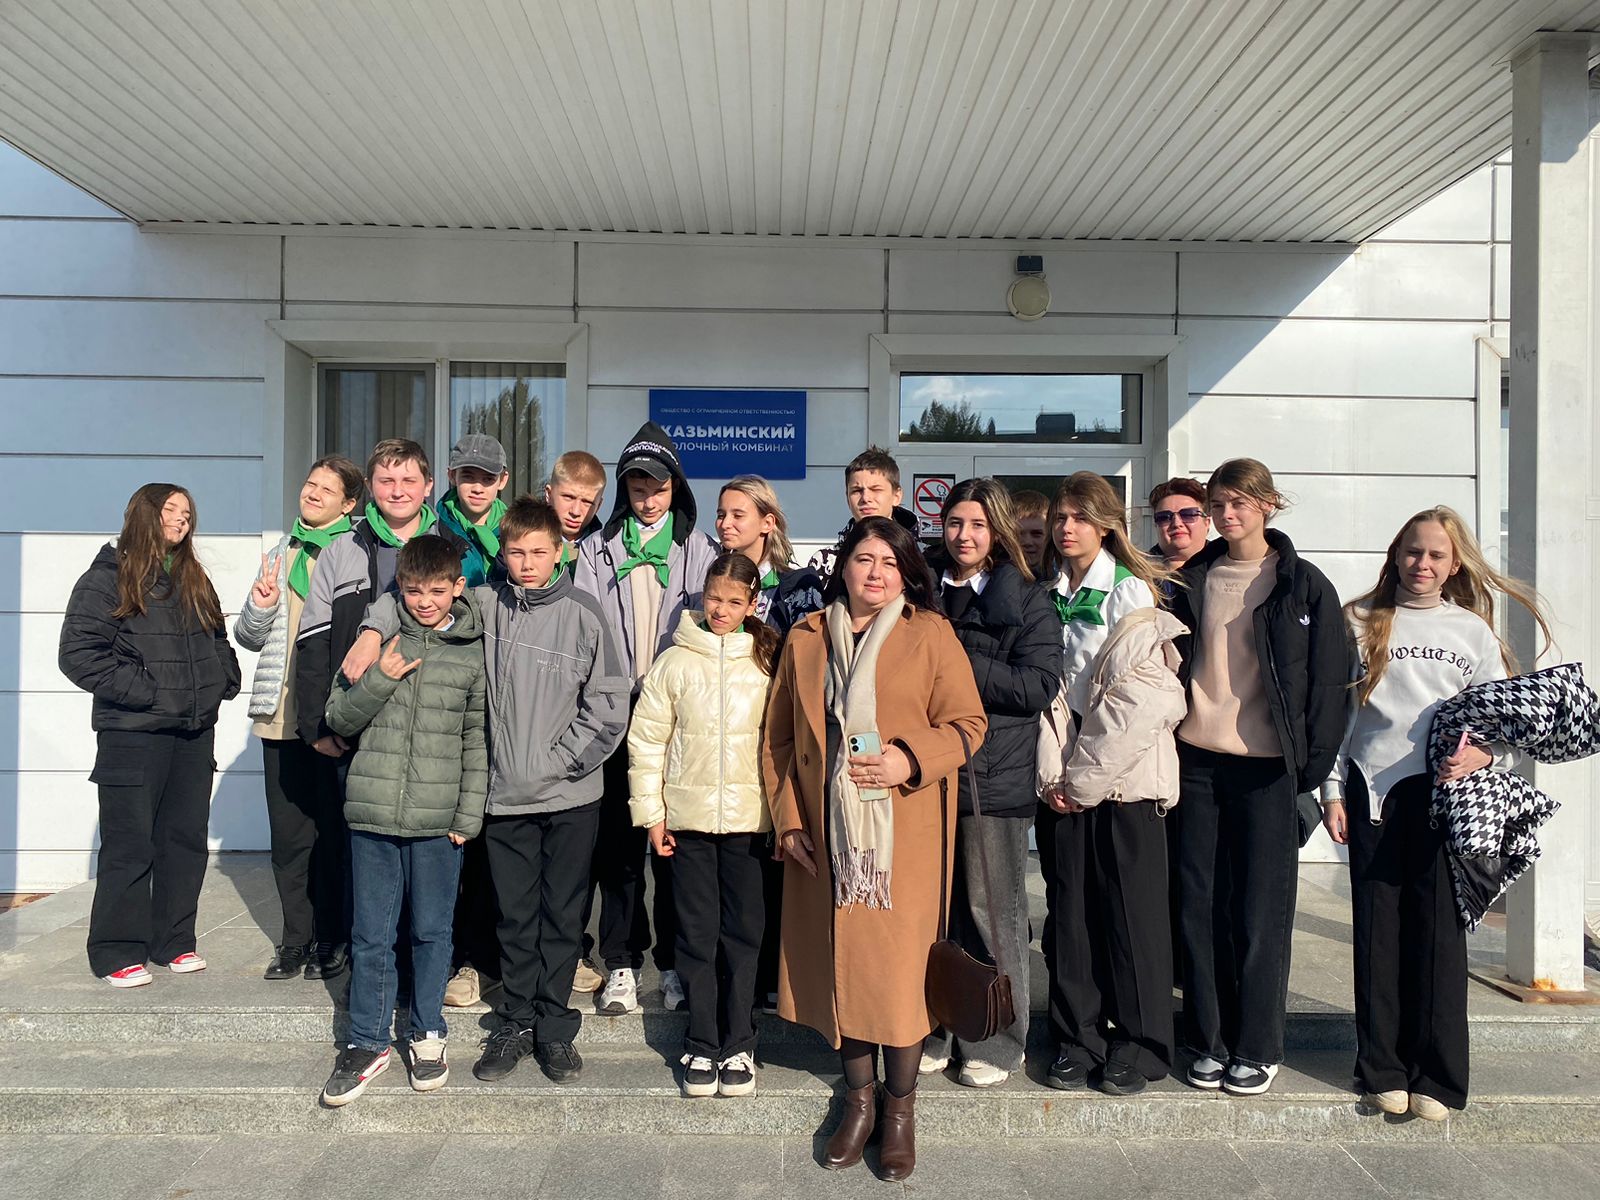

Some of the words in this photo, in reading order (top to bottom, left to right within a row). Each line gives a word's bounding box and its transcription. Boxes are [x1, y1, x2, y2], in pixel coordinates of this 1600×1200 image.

[738, 408, 796, 416] ОТВЕТСТВЕННОСТЬЮ
[660, 423, 796, 440] КАЗЬМИНСКИЙ
[672, 440, 729, 452] ОЛОЧНЫЙ
[732, 442, 793, 453] КОМБИНАТ
